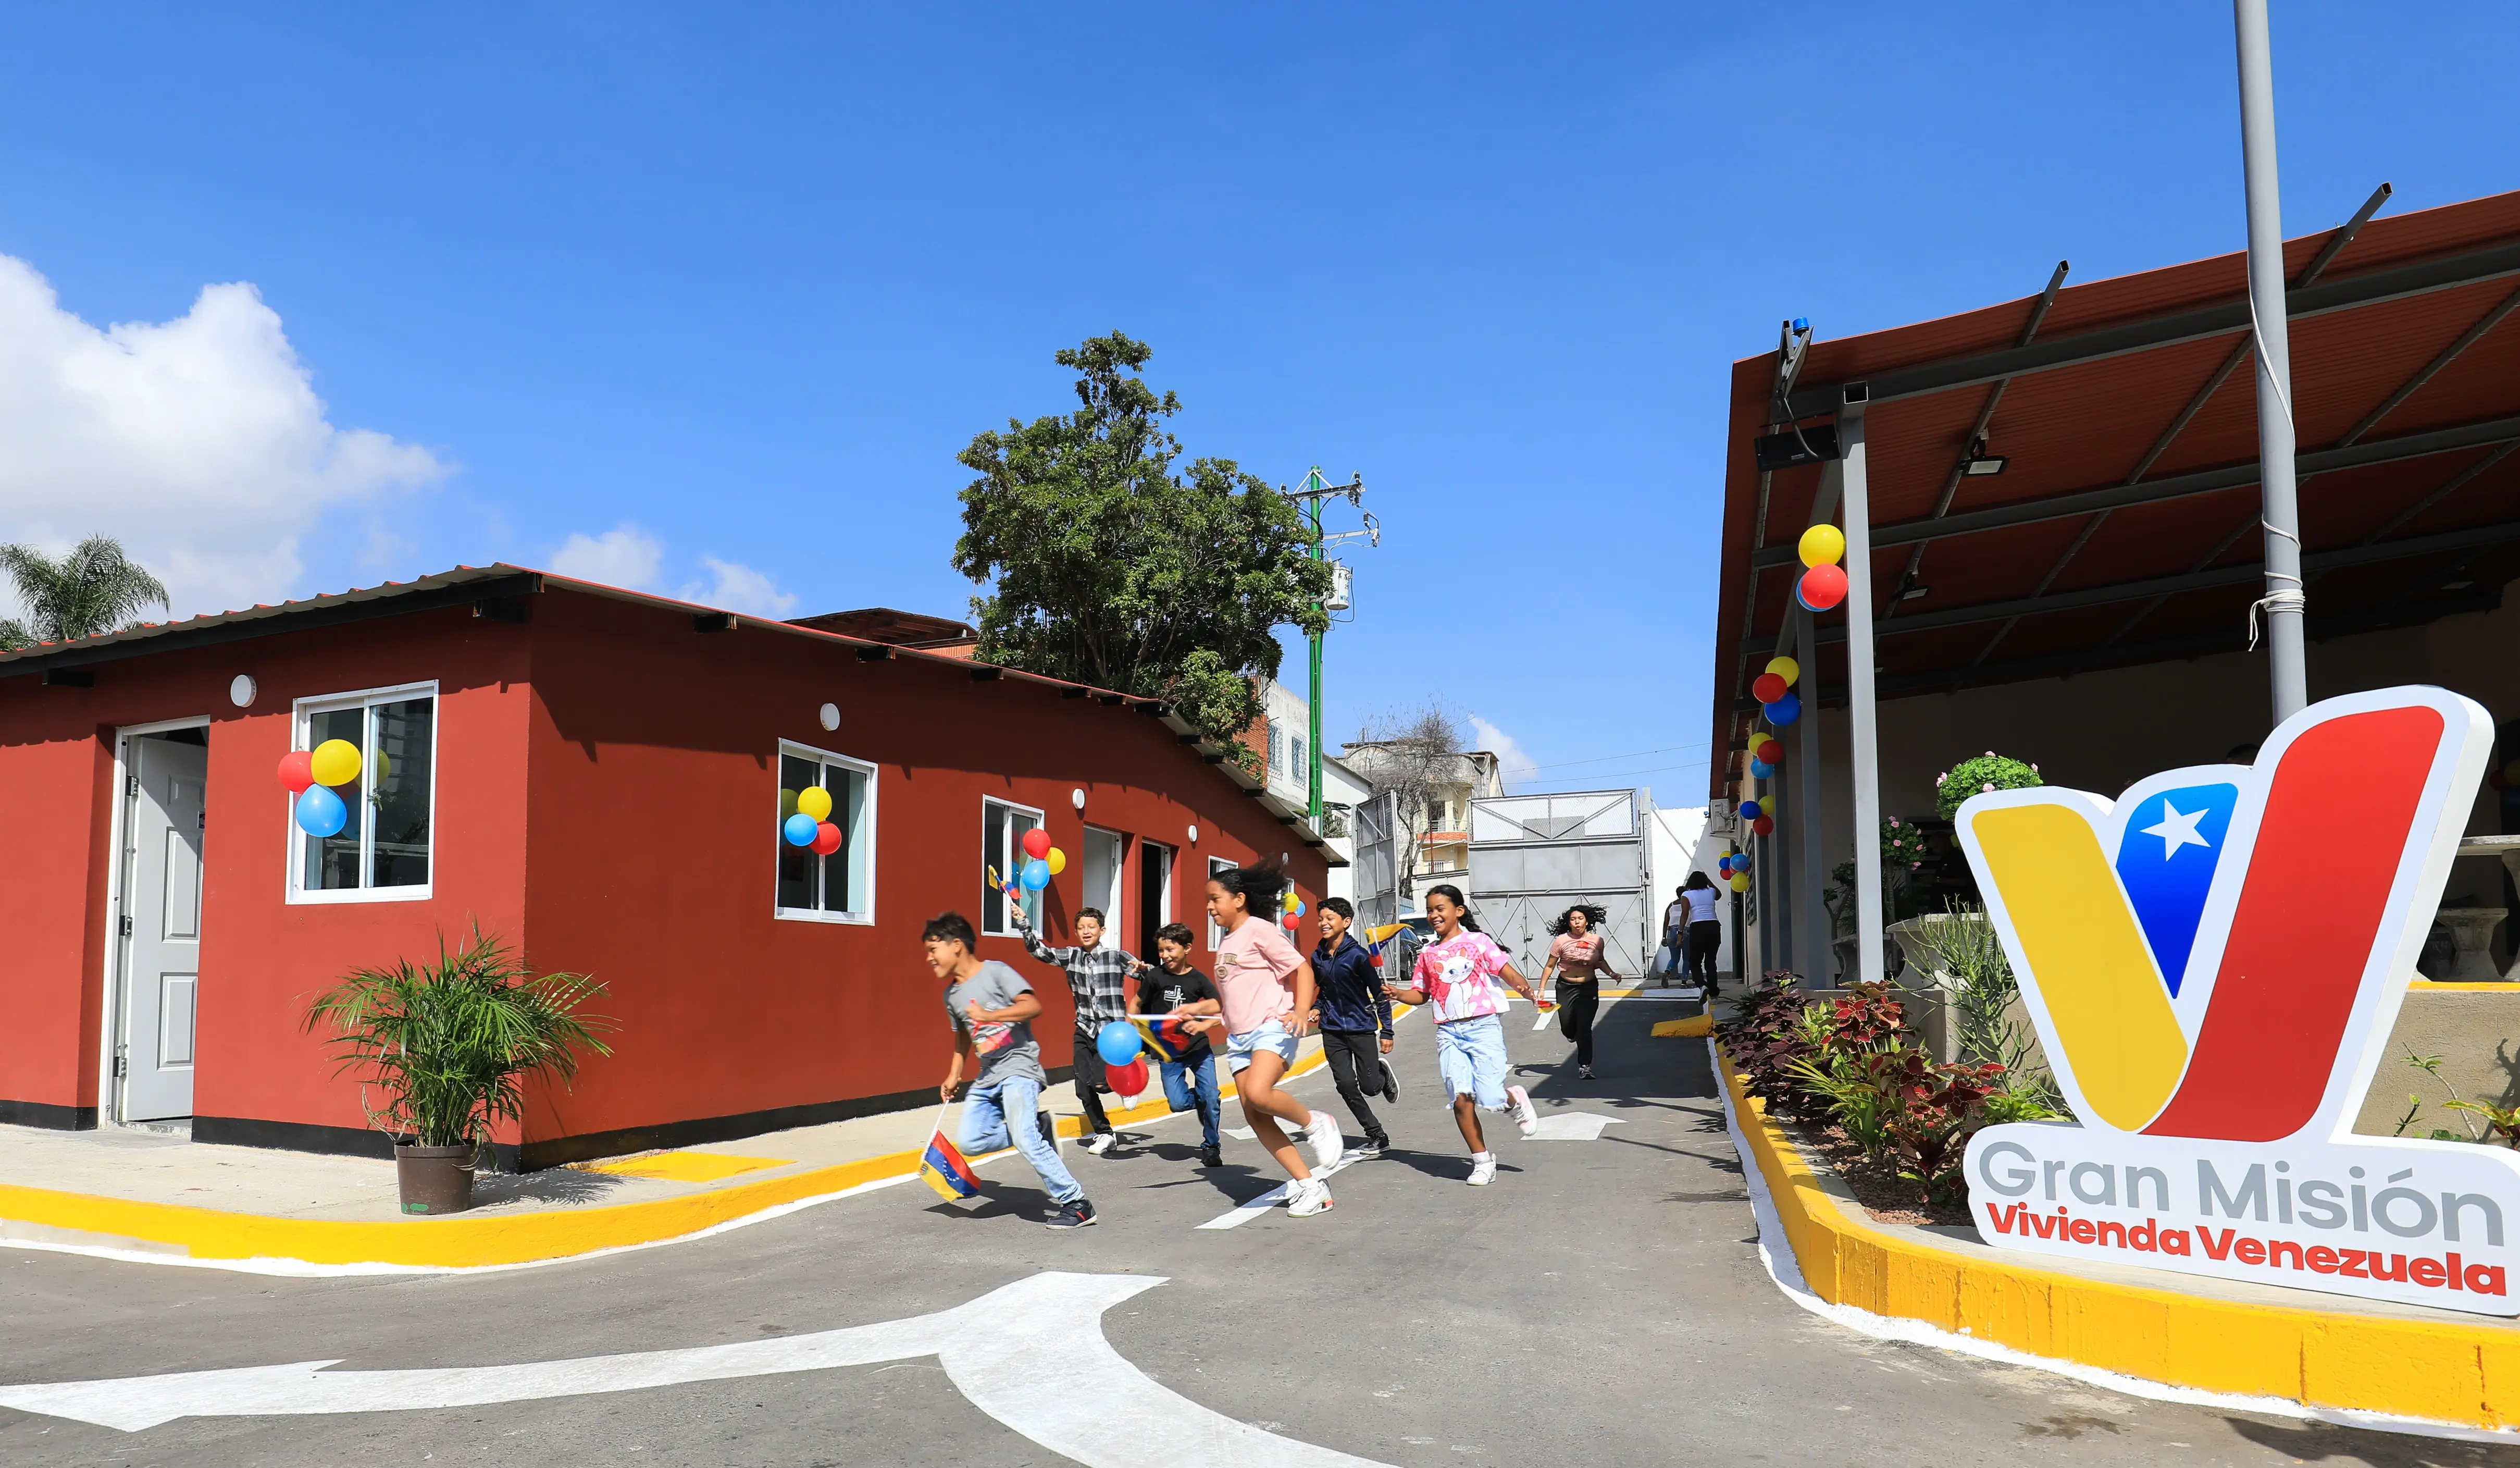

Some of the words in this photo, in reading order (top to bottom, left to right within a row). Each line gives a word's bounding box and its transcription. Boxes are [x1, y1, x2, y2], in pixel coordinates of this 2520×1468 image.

[1979, 1141, 2170, 1212] Gran
[2196, 1159, 2505, 1247] Misión
[1985, 1201, 2191, 1257] Vivienda
[2196, 1226, 2507, 1297] Venezuela
